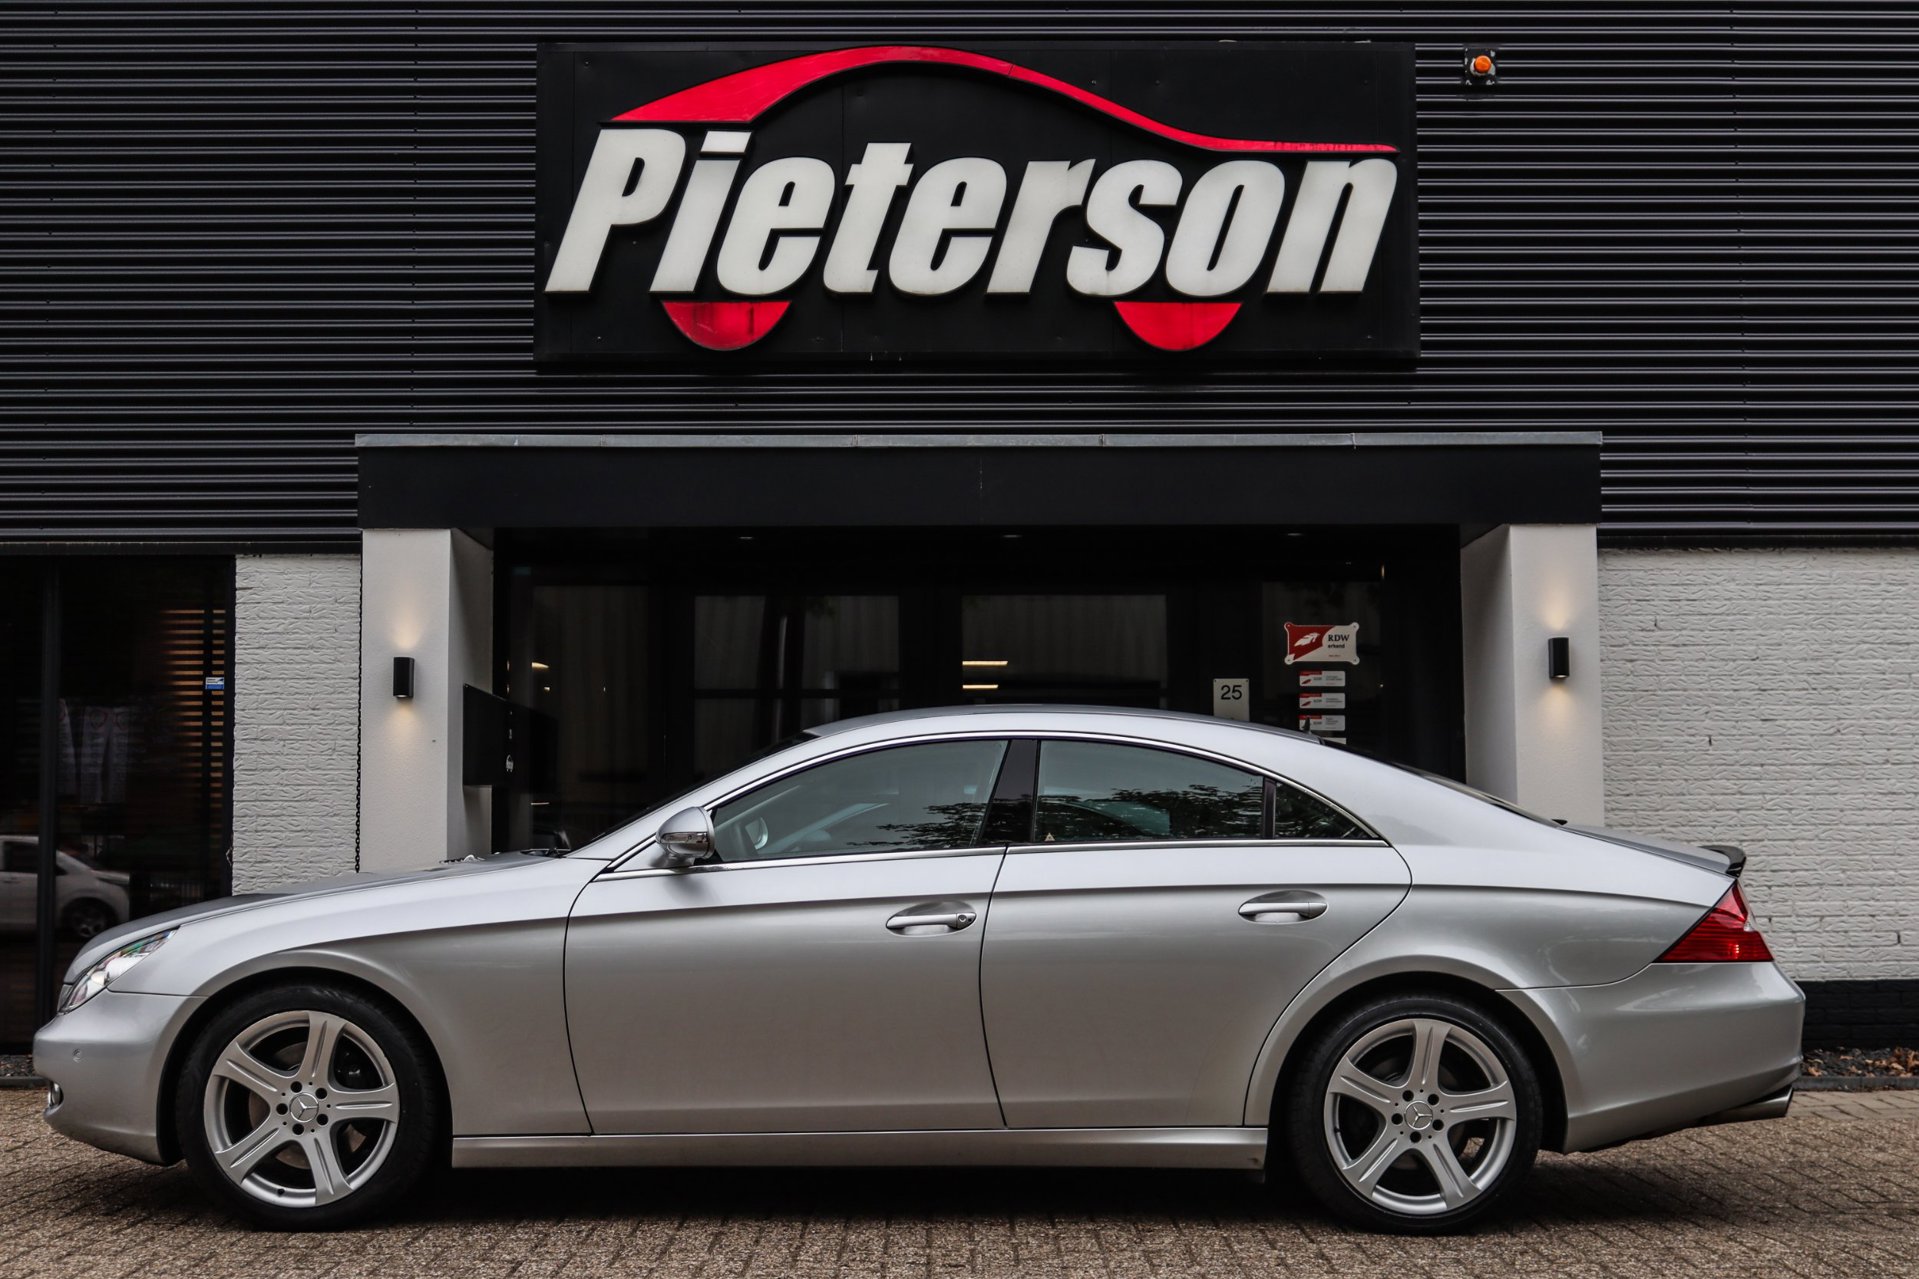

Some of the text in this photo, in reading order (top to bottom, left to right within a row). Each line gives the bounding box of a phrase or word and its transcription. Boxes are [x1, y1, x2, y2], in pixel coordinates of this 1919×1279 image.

[546, 128, 1397, 296] Pieterson
[1328, 634, 1350, 642] RDW
[1221, 684, 1243, 700] 25
